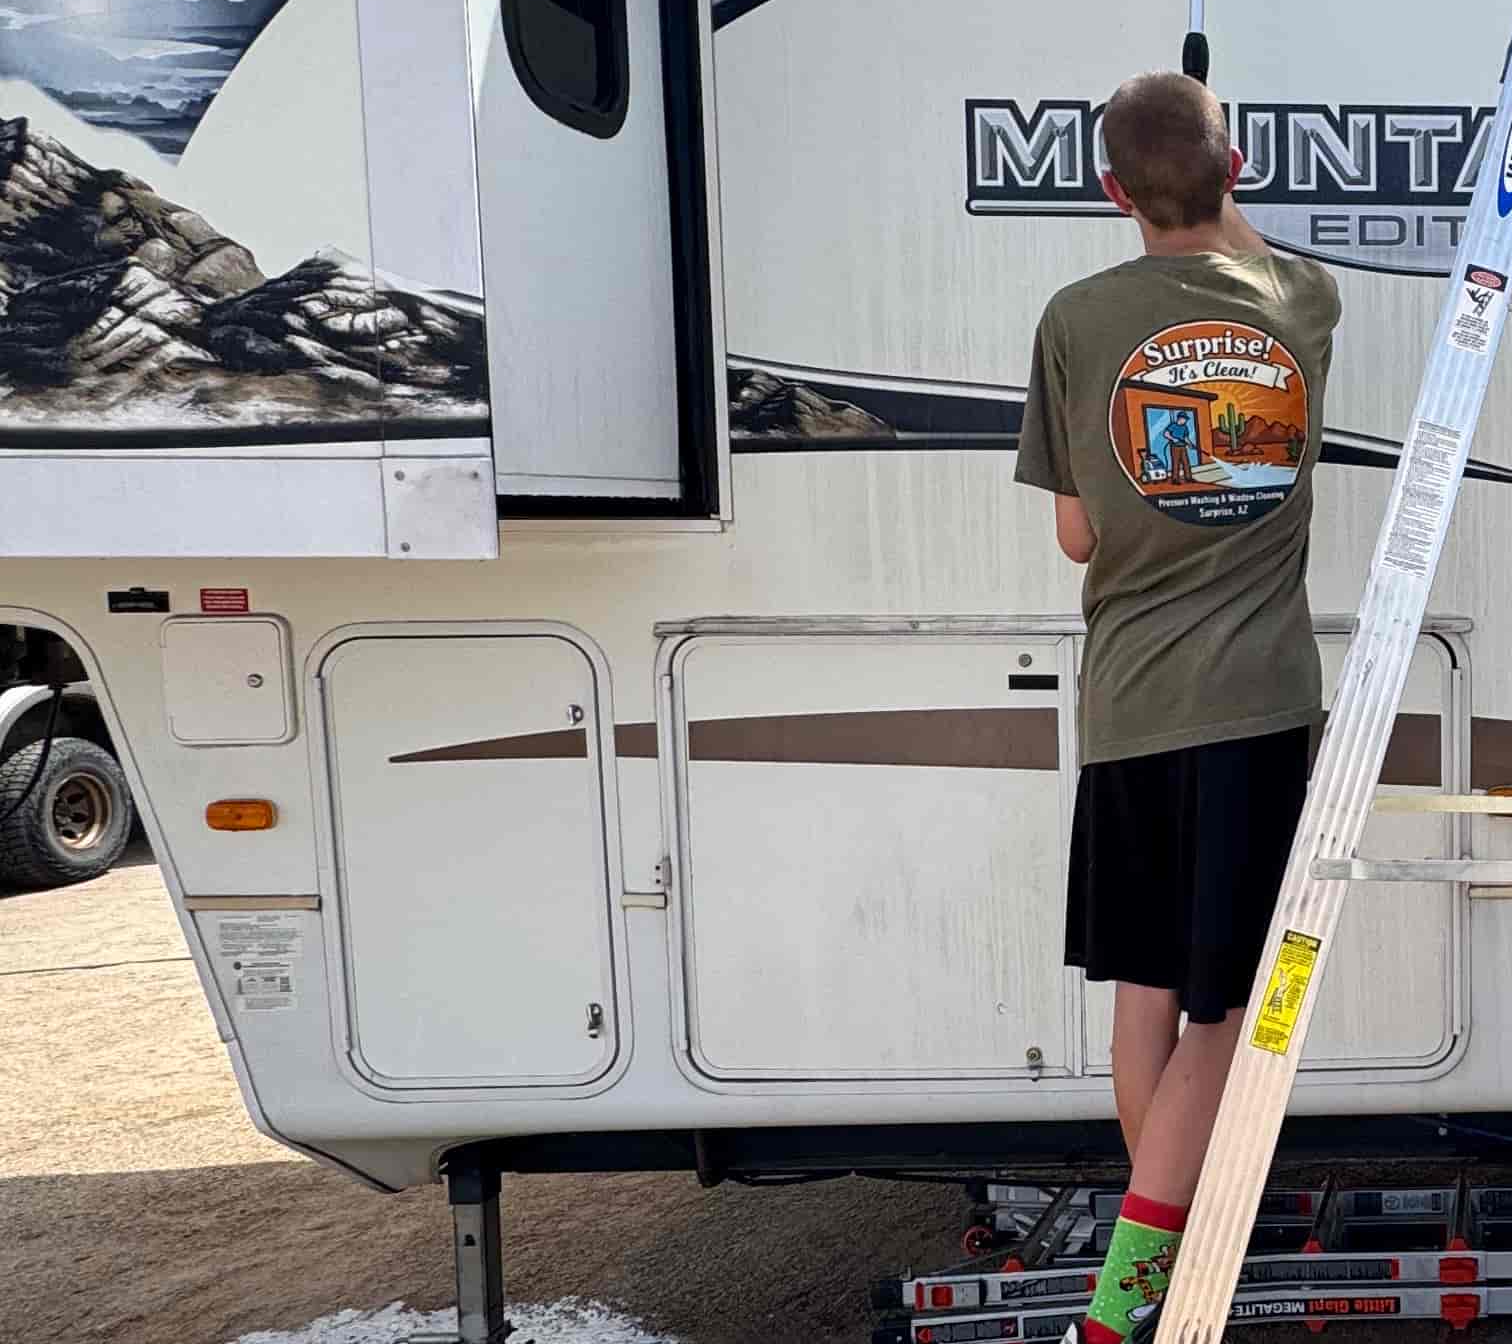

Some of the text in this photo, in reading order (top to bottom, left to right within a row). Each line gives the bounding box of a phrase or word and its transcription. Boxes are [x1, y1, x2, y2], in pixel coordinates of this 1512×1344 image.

[1143, 330, 1274, 366] Surprise!
[1168, 361, 1258, 384] It's Clean!
[1190, 495, 1220, 505] Washing
[1238, 505, 1249, 514] AZ
[1234, 1302, 1305, 1316] MEGALITE
